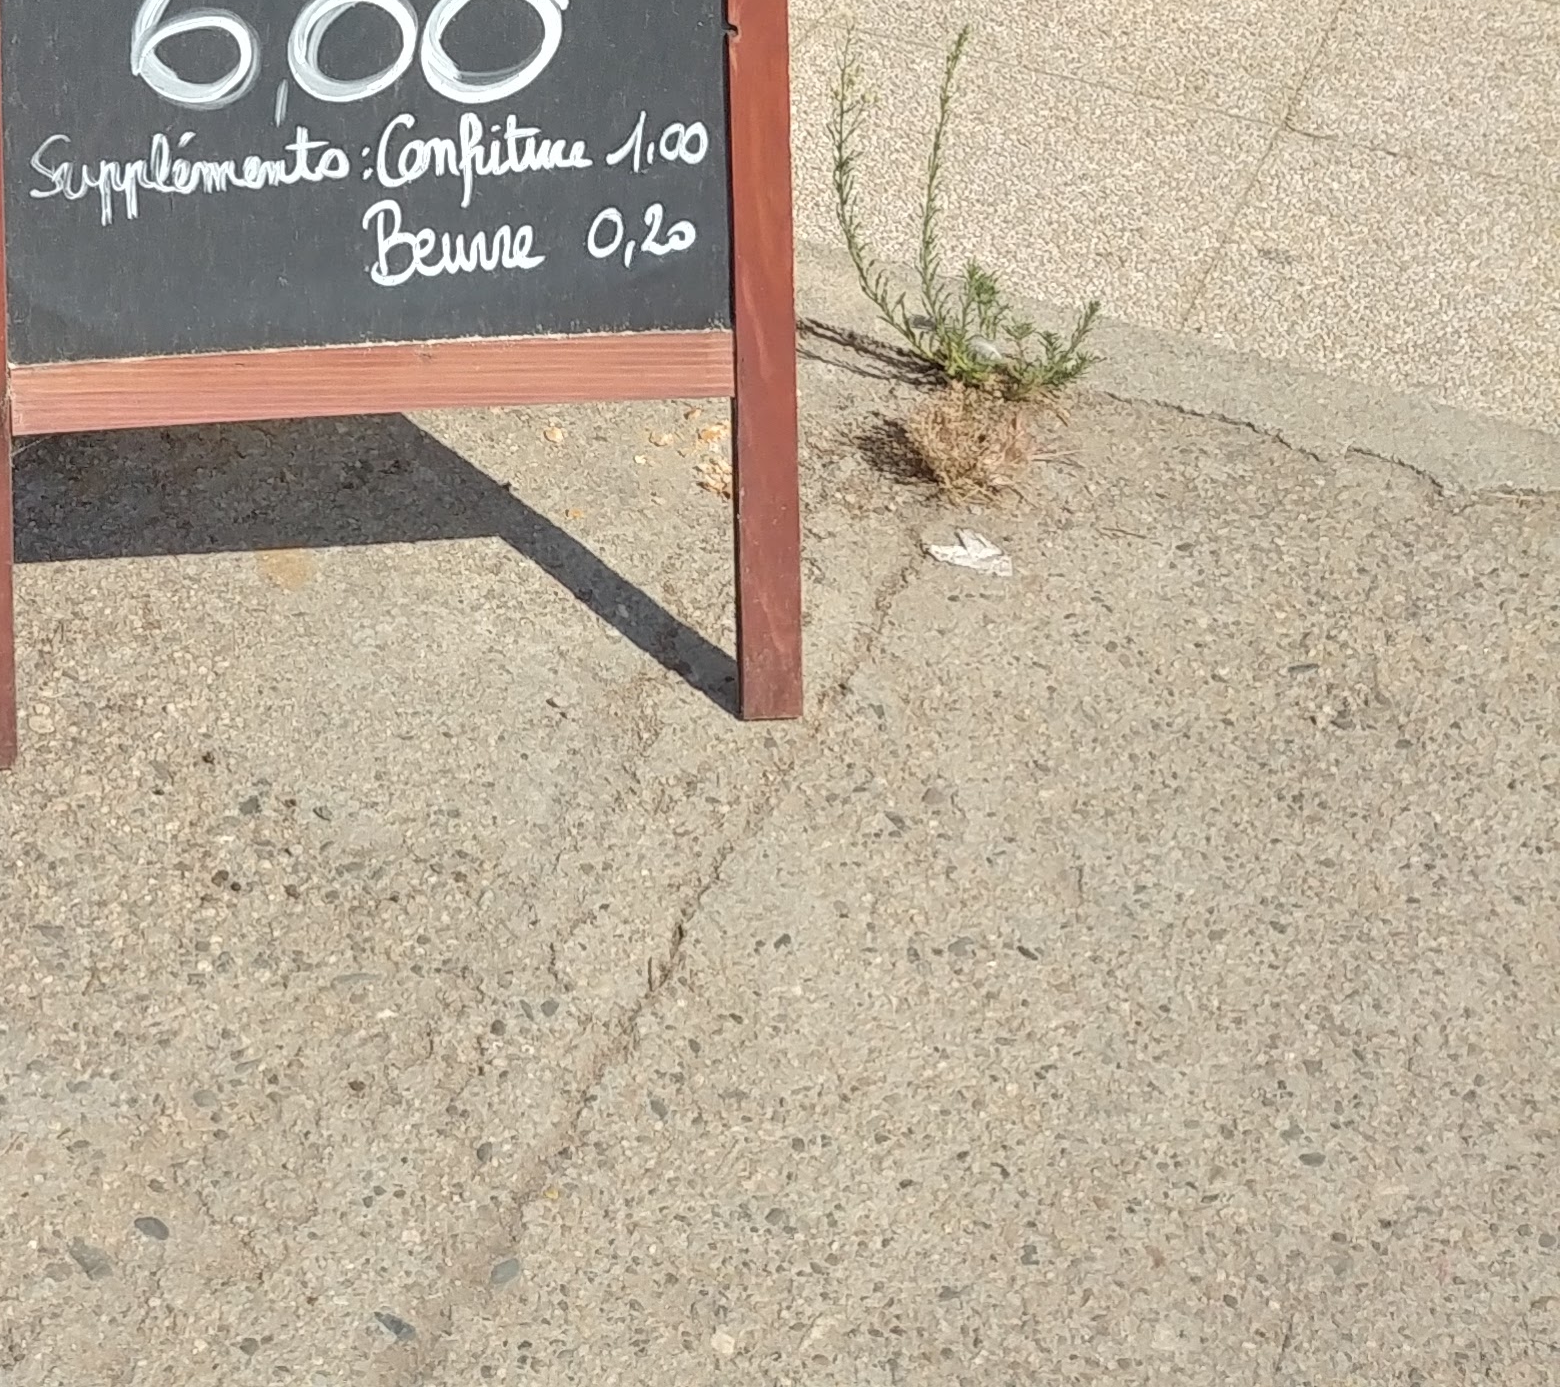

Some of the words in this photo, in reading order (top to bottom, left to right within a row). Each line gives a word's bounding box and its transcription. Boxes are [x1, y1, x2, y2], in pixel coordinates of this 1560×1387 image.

[376, 112, 594, 208] Confiture
[606, 110, 710, 174] 1,00
[362, 199, 546, 286] Beurre
[586, 204, 696, 268] 0,20
